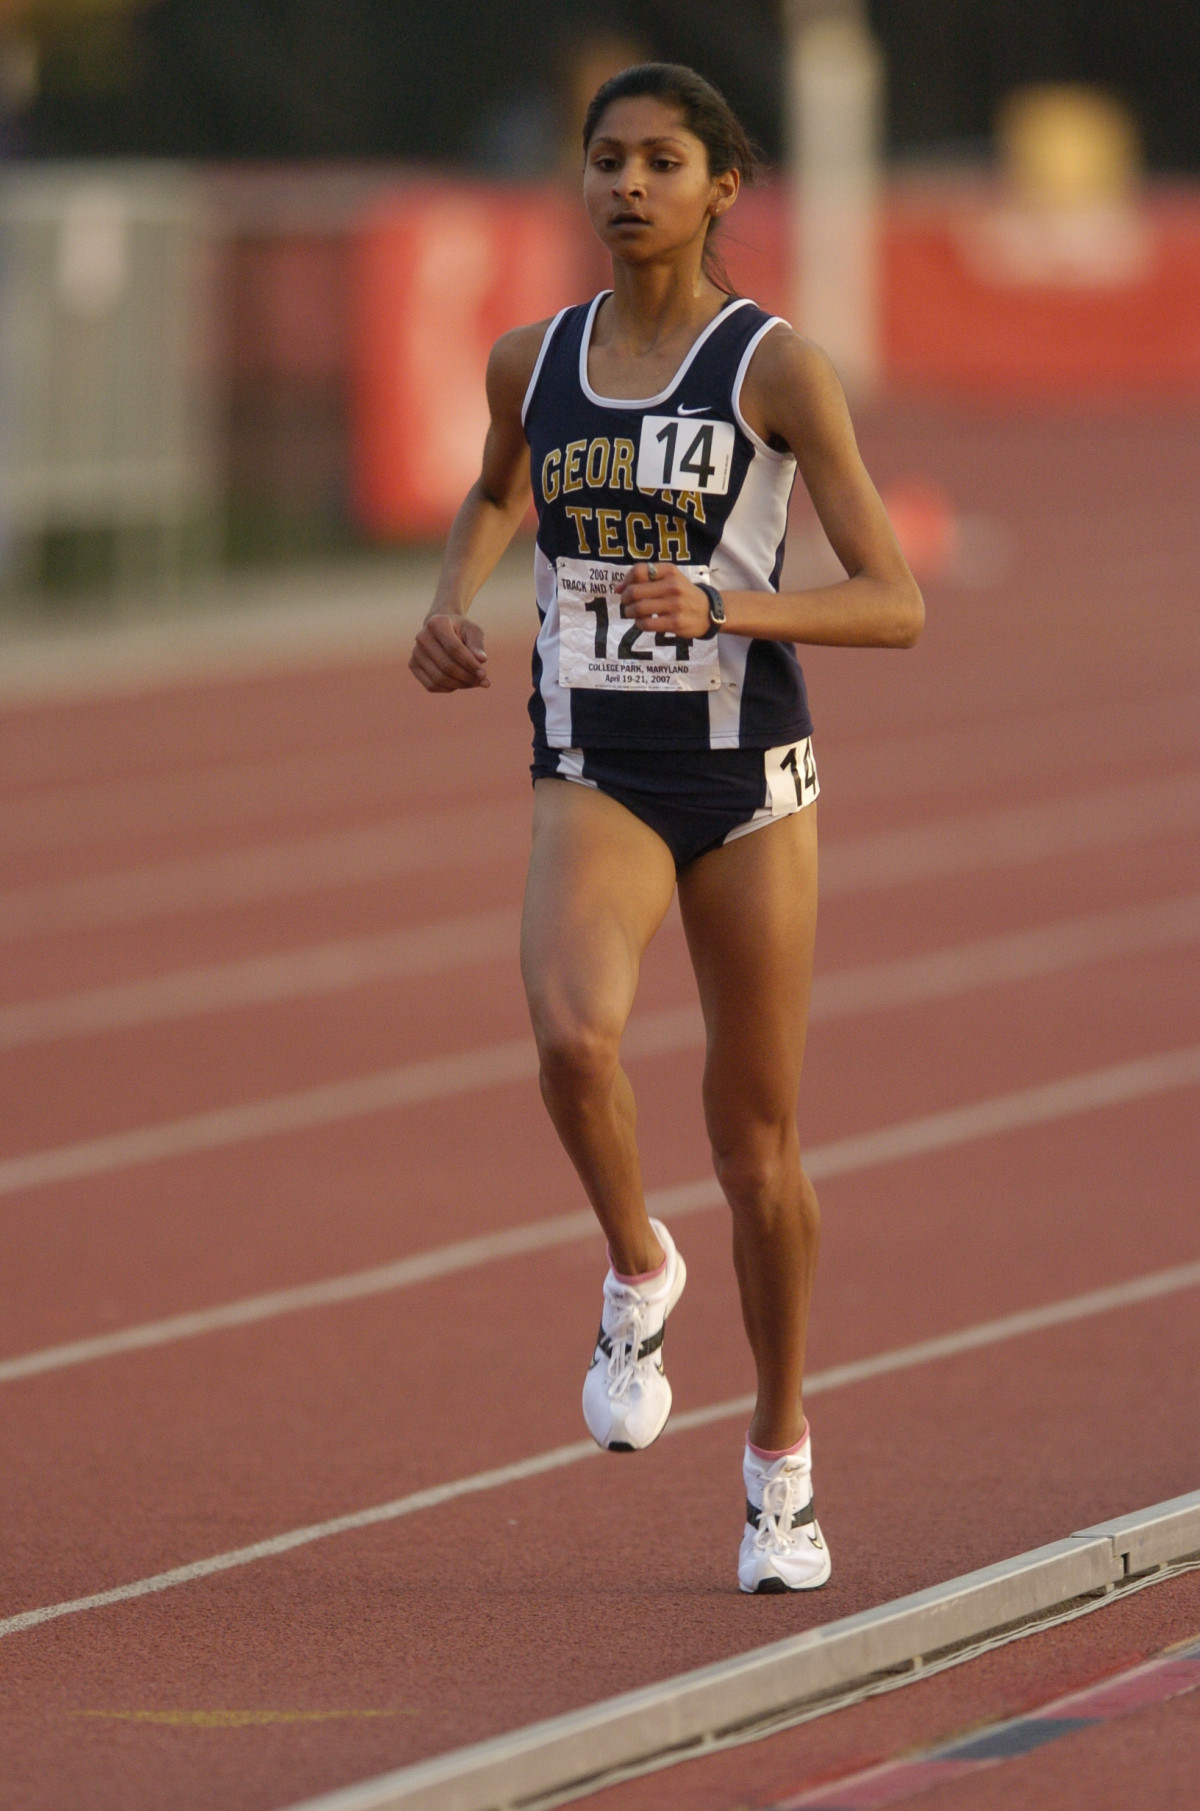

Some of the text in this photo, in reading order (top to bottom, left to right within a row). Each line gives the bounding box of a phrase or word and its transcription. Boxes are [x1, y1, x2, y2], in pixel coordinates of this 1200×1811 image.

[656, 422, 716, 488] 14
[541, 437, 706, 524] GEORA
[565, 506, 691, 561] TECH
[561, 578, 587, 593] TRACK
[589, 582, 607, 594] AND
[589, 568, 608, 581] 2007
[588, 663, 689, 674] COLLEGE PARK, MARYLAND
[605, 674, 671, 684] April 19-21, 2007
[780, 736, 816, 807] 14
